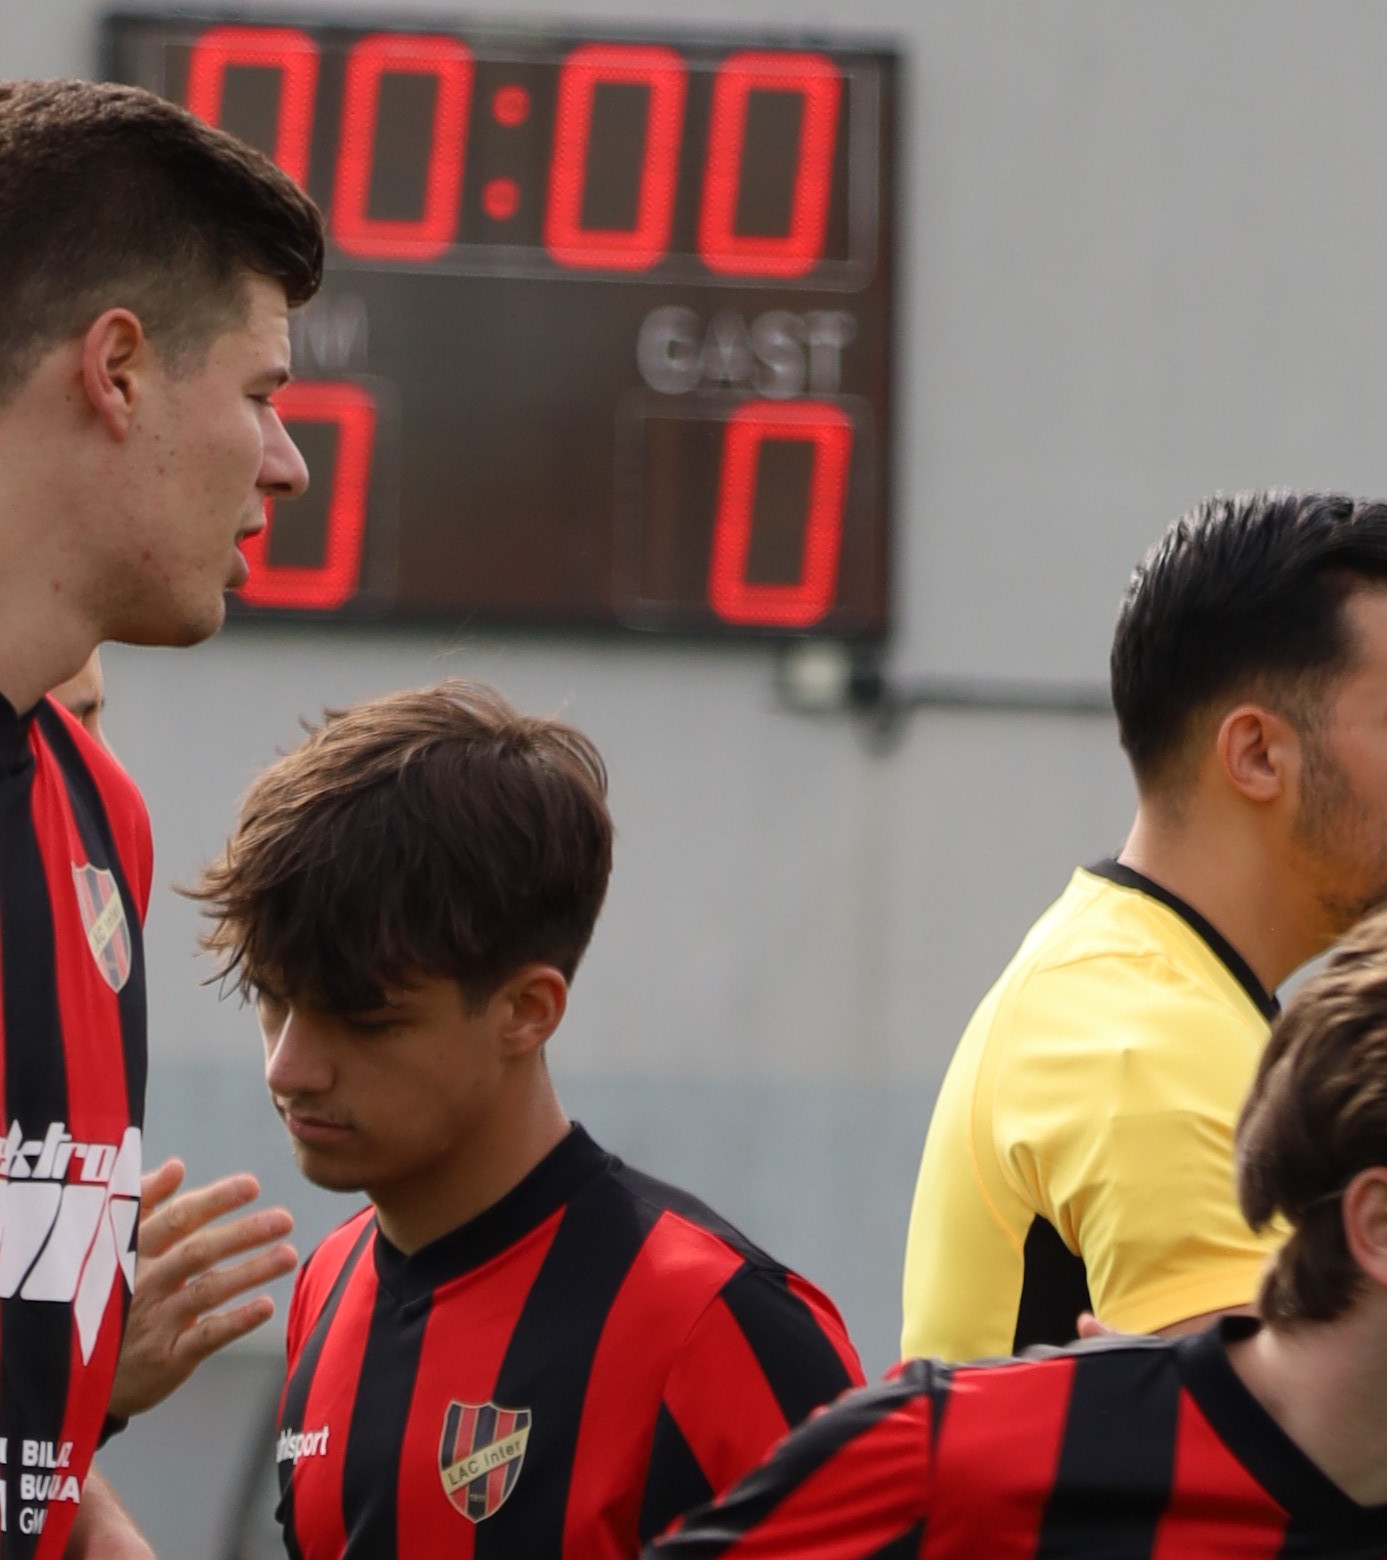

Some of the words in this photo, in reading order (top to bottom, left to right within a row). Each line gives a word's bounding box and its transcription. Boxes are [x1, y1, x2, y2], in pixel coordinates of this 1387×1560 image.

[637, 304, 857, 399] GAST
[707, 400, 852, 628] 0
[449, 1460, 480, 1486] LAC
[483, 1440, 521, 1467] Inter
